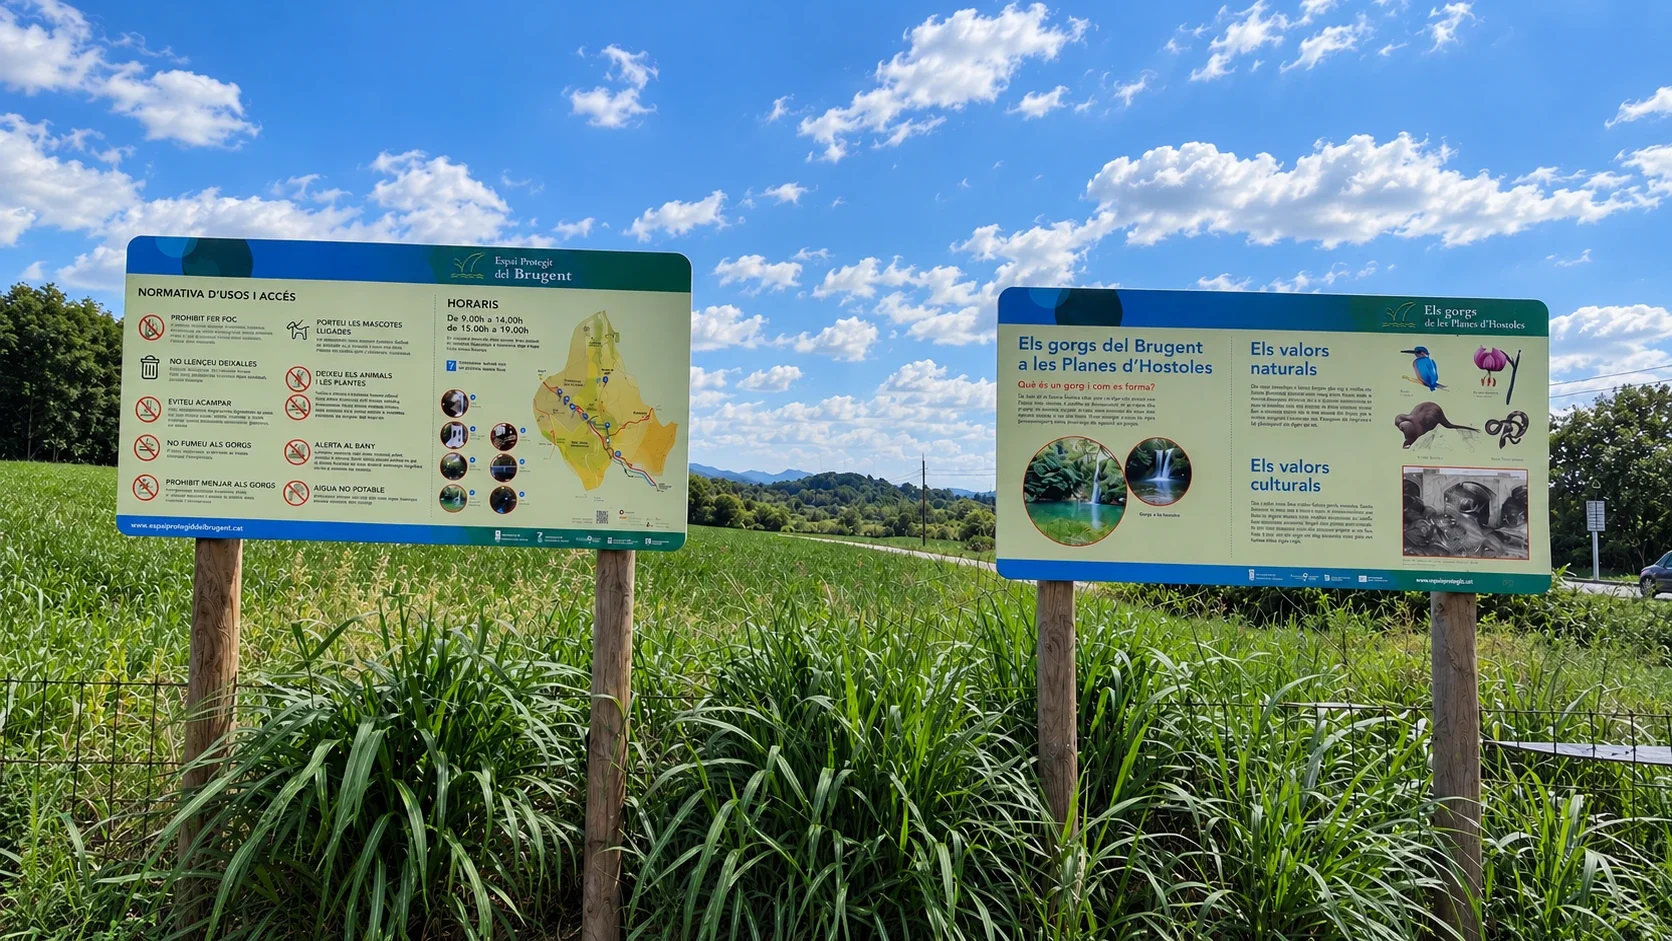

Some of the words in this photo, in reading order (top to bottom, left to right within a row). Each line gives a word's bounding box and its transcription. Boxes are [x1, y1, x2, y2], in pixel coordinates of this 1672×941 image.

[495, 256, 517, 267] Espai
[520, 258, 553, 269] Protegit
[495, 269, 509, 278] del
[514, 268, 572, 284] Brugent
[138, 288, 204, 298] NORMATIVA
[208, 290, 249, 300] D'USOS
[259, 290, 296, 301] ACCÉS
[447, 298, 499, 309] HORARIS
[1425, 305, 1441, 315] Els
[1445, 308, 1477, 319] gorgs
[447, 315, 459, 323] De
[461, 315, 485, 323] 9.00h
[495, 316, 523, 324] 14.00h
[1425, 318, 1435, 327] de
[1451, 319, 1478, 328] Planes
[447, 324, 458, 332] de
[461, 325, 489, 333] 15.00h
[500, 326, 529, 334] 19.00h
[1018, 336, 1042, 351] Els
[1048, 339, 1097, 355] gorgs
[1103, 338, 1128, 353] del
[1135, 339, 1203, 357] Brugent
[1250, 341, 1274, 357] Els
[1278, 343, 1329, 358] valors
[1018, 359, 1027, 370] a
[1033, 356, 1056, 371] les
[1062, 358, 1117, 373] Planes
[1122, 359, 1212, 374] d'Hostoles
[1250, 360, 1317, 376] naturals
[1064, 382, 1085, 391] gorg
[1125, 382, 1155, 391] forma?
[1250, 458, 1275, 473] Els
[1279, 459, 1330, 474] valors
[1250, 477, 1320, 493] culturals
